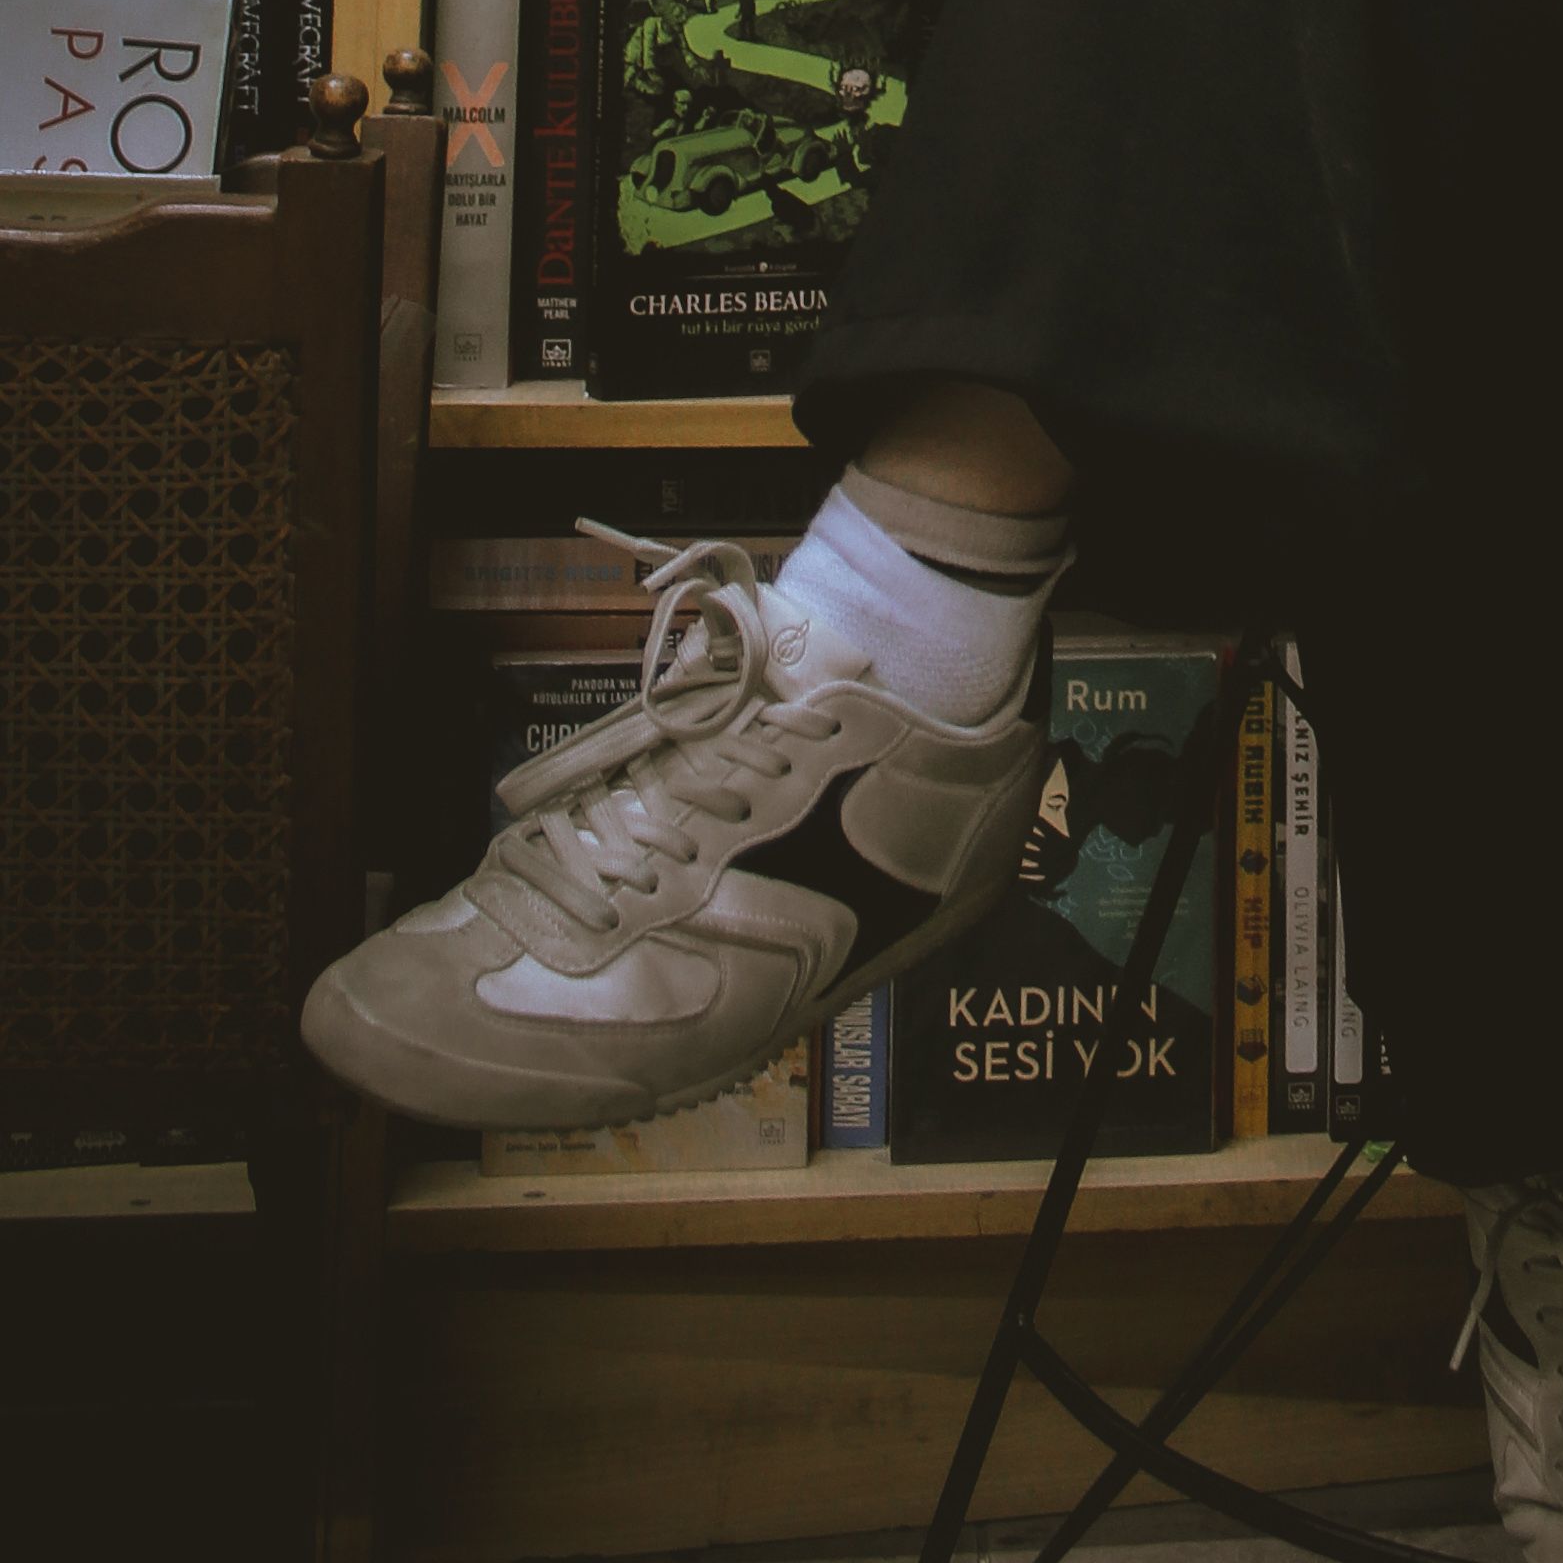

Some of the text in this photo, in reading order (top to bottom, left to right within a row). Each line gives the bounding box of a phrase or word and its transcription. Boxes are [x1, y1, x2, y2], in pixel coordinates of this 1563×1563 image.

[441, 62, 509, 168] X
[442, 106, 506, 124] MALCOLM
[447, 193, 474, 209] DOLU
[454, 213, 489, 228] HAYAT
[536, 296, 579, 310] MATTHEW
[628, 292, 748, 318] CHARLES
[542, 309, 570, 321] PEARL
[719, 319, 782, 336] bir rüya
[532, 692, 594, 705] KÖTÜLÜKLER
[1065, 680, 1148, 712] Rum
[1290, 772, 1311, 837] ŞEHİR
[1294, 885, 1311, 1030] OLIVIA LAING
[952, 1030, 1055, 1082] SESİ
[829, 1073, 871, 1128] SARAYI
